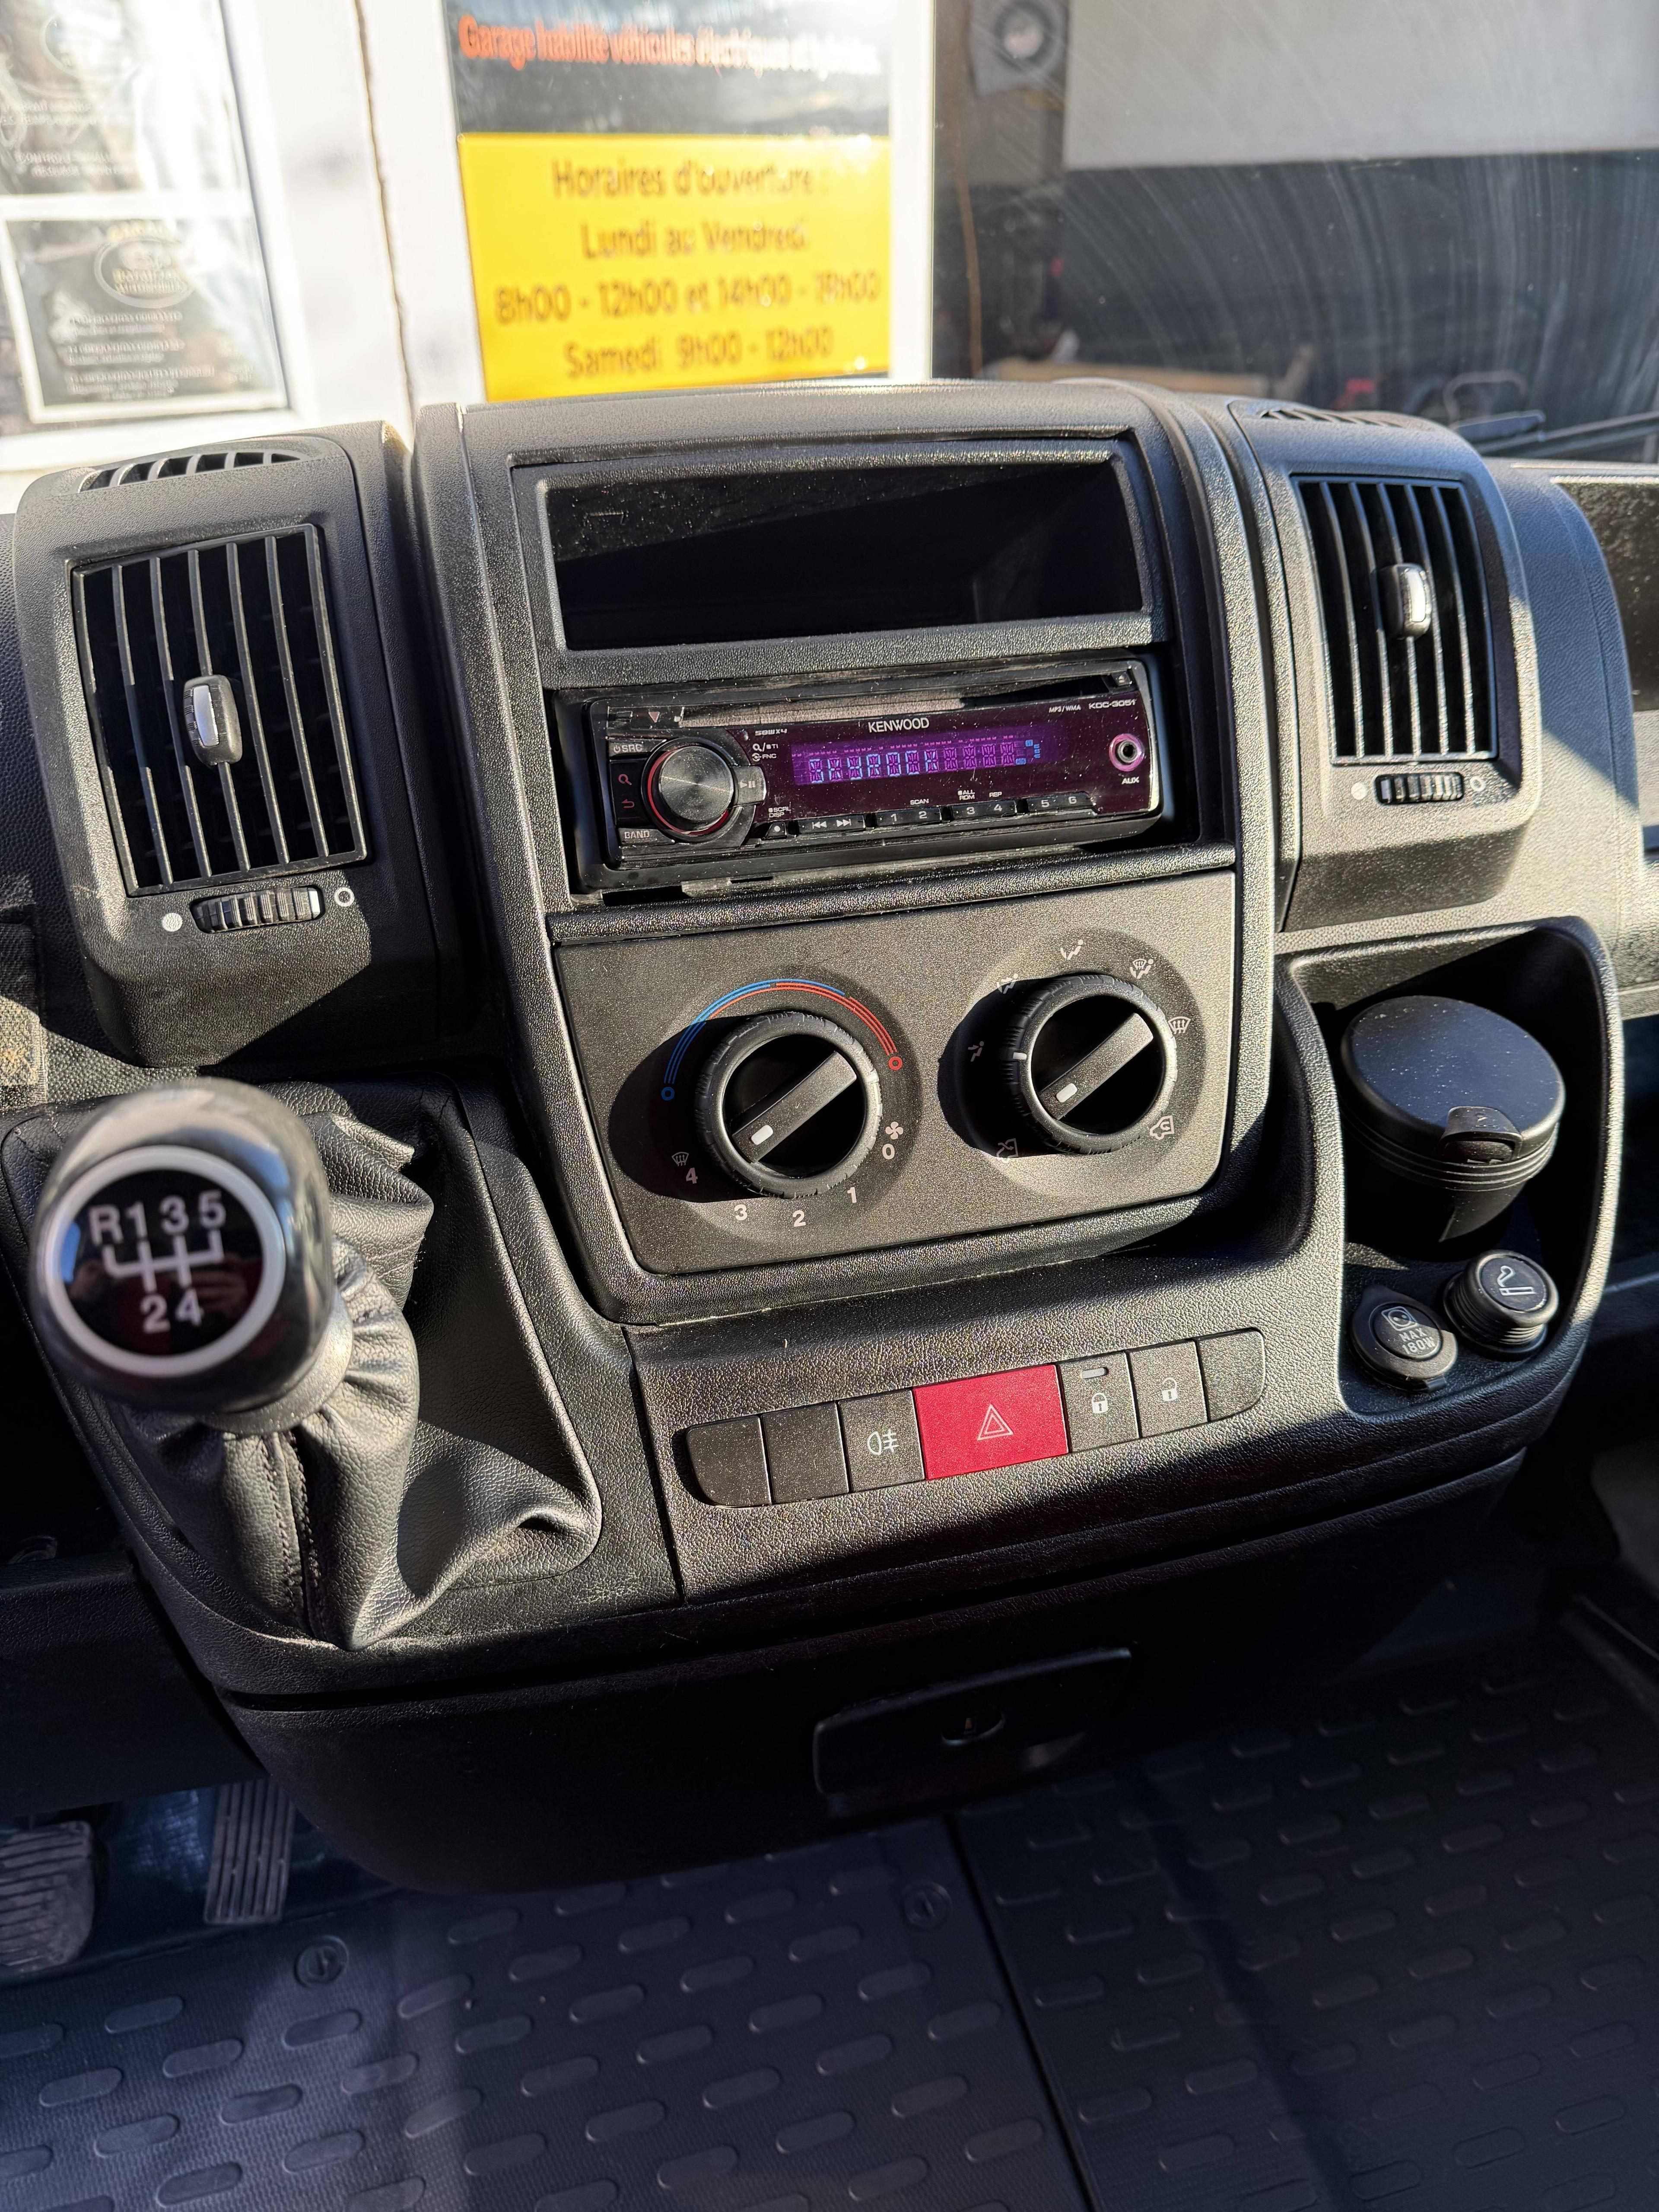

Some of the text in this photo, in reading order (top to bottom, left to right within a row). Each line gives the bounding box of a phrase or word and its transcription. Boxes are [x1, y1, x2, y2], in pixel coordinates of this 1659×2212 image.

[458, 14, 536, 70] Garage
[551, 159, 667, 198] Horaires
[580, 217, 656, 260] Lundi
[664, 228, 696, 257] au
[493, 281, 572, 326] 8h00
[597, 275, 677, 320] 12h00
[685, 279, 710, 312] et
[563, 336, 662, 379] Samedi
[676, 330, 742, 369] 9h00
[765, 324, 834, 363] 12h00
[1049, 704, 1081, 713] MP3/WMA
[868, 718, 930, 733] KENWOOD
[621, 744, 643, 752] SRC
[1121, 776, 1140, 785] AUX
[890, 813, 898, 821] 1
[918, 810, 928, 819] 2
[966, 807, 976, 815] 3
[1041, 799, 1050, 807] 5
[1068, 796, 1077, 804] 6
[882, 1144, 895, 1160] 0
[685, 1167, 698, 1185] 4
[847, 1186, 858, 1203] 1
[89, 1189, 226, 1247] R 1 3 5
[734, 1204, 747, 1220] 3
[792, 1210, 806, 1227] 2
[140, 1290, 204, 1334] 2 4
[1398, 1328, 1427, 1342] MAX
[1402, 1336, 1436, 1355] 180W
